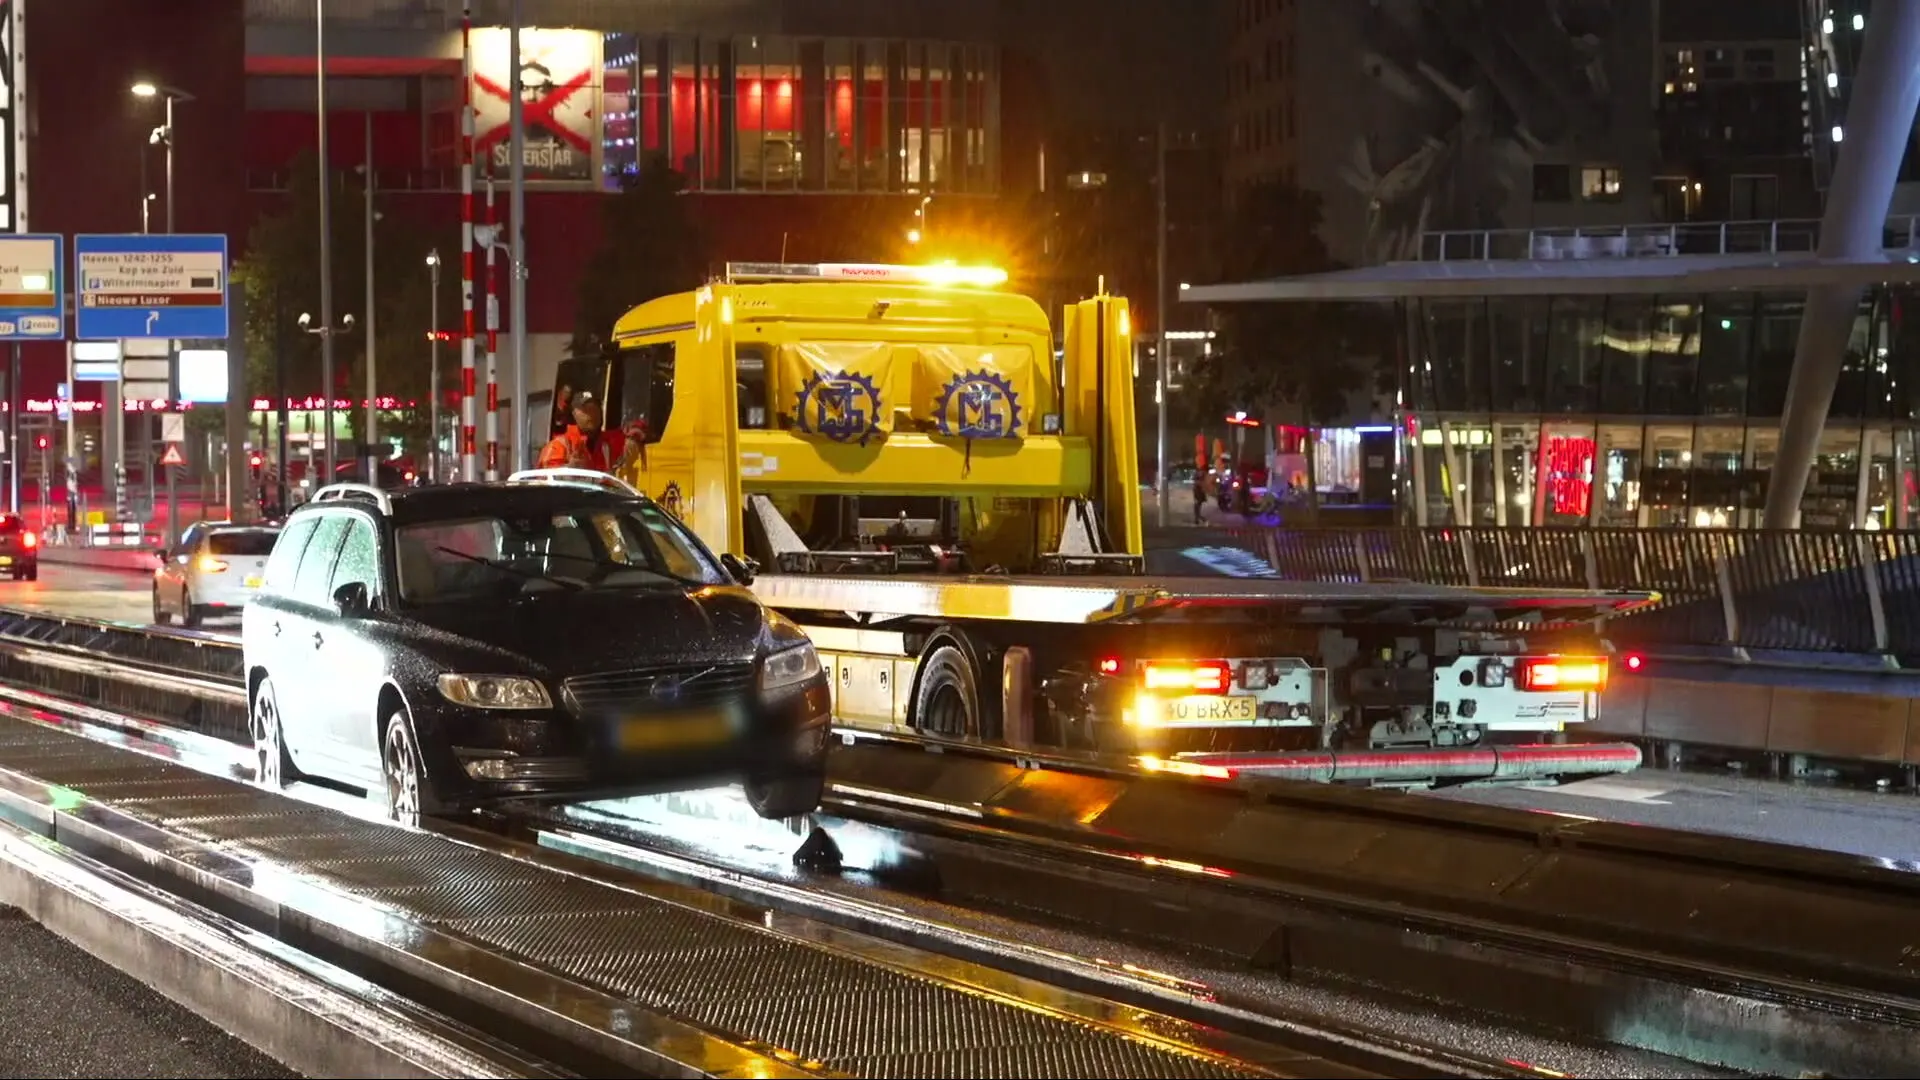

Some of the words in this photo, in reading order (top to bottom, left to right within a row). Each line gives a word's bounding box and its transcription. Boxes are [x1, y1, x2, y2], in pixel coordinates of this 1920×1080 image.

[83, 254, 120, 263] Havens
[123, 253, 174, 263] 1242-1255
[119, 265, 138, 275] Kop
[162, 264, 184, 274] Zuid
[102, 277, 180, 288] Wilhelminapier
[98, 295, 137, 305] Nieuwe
[140, 295, 171, 305] Luxor
